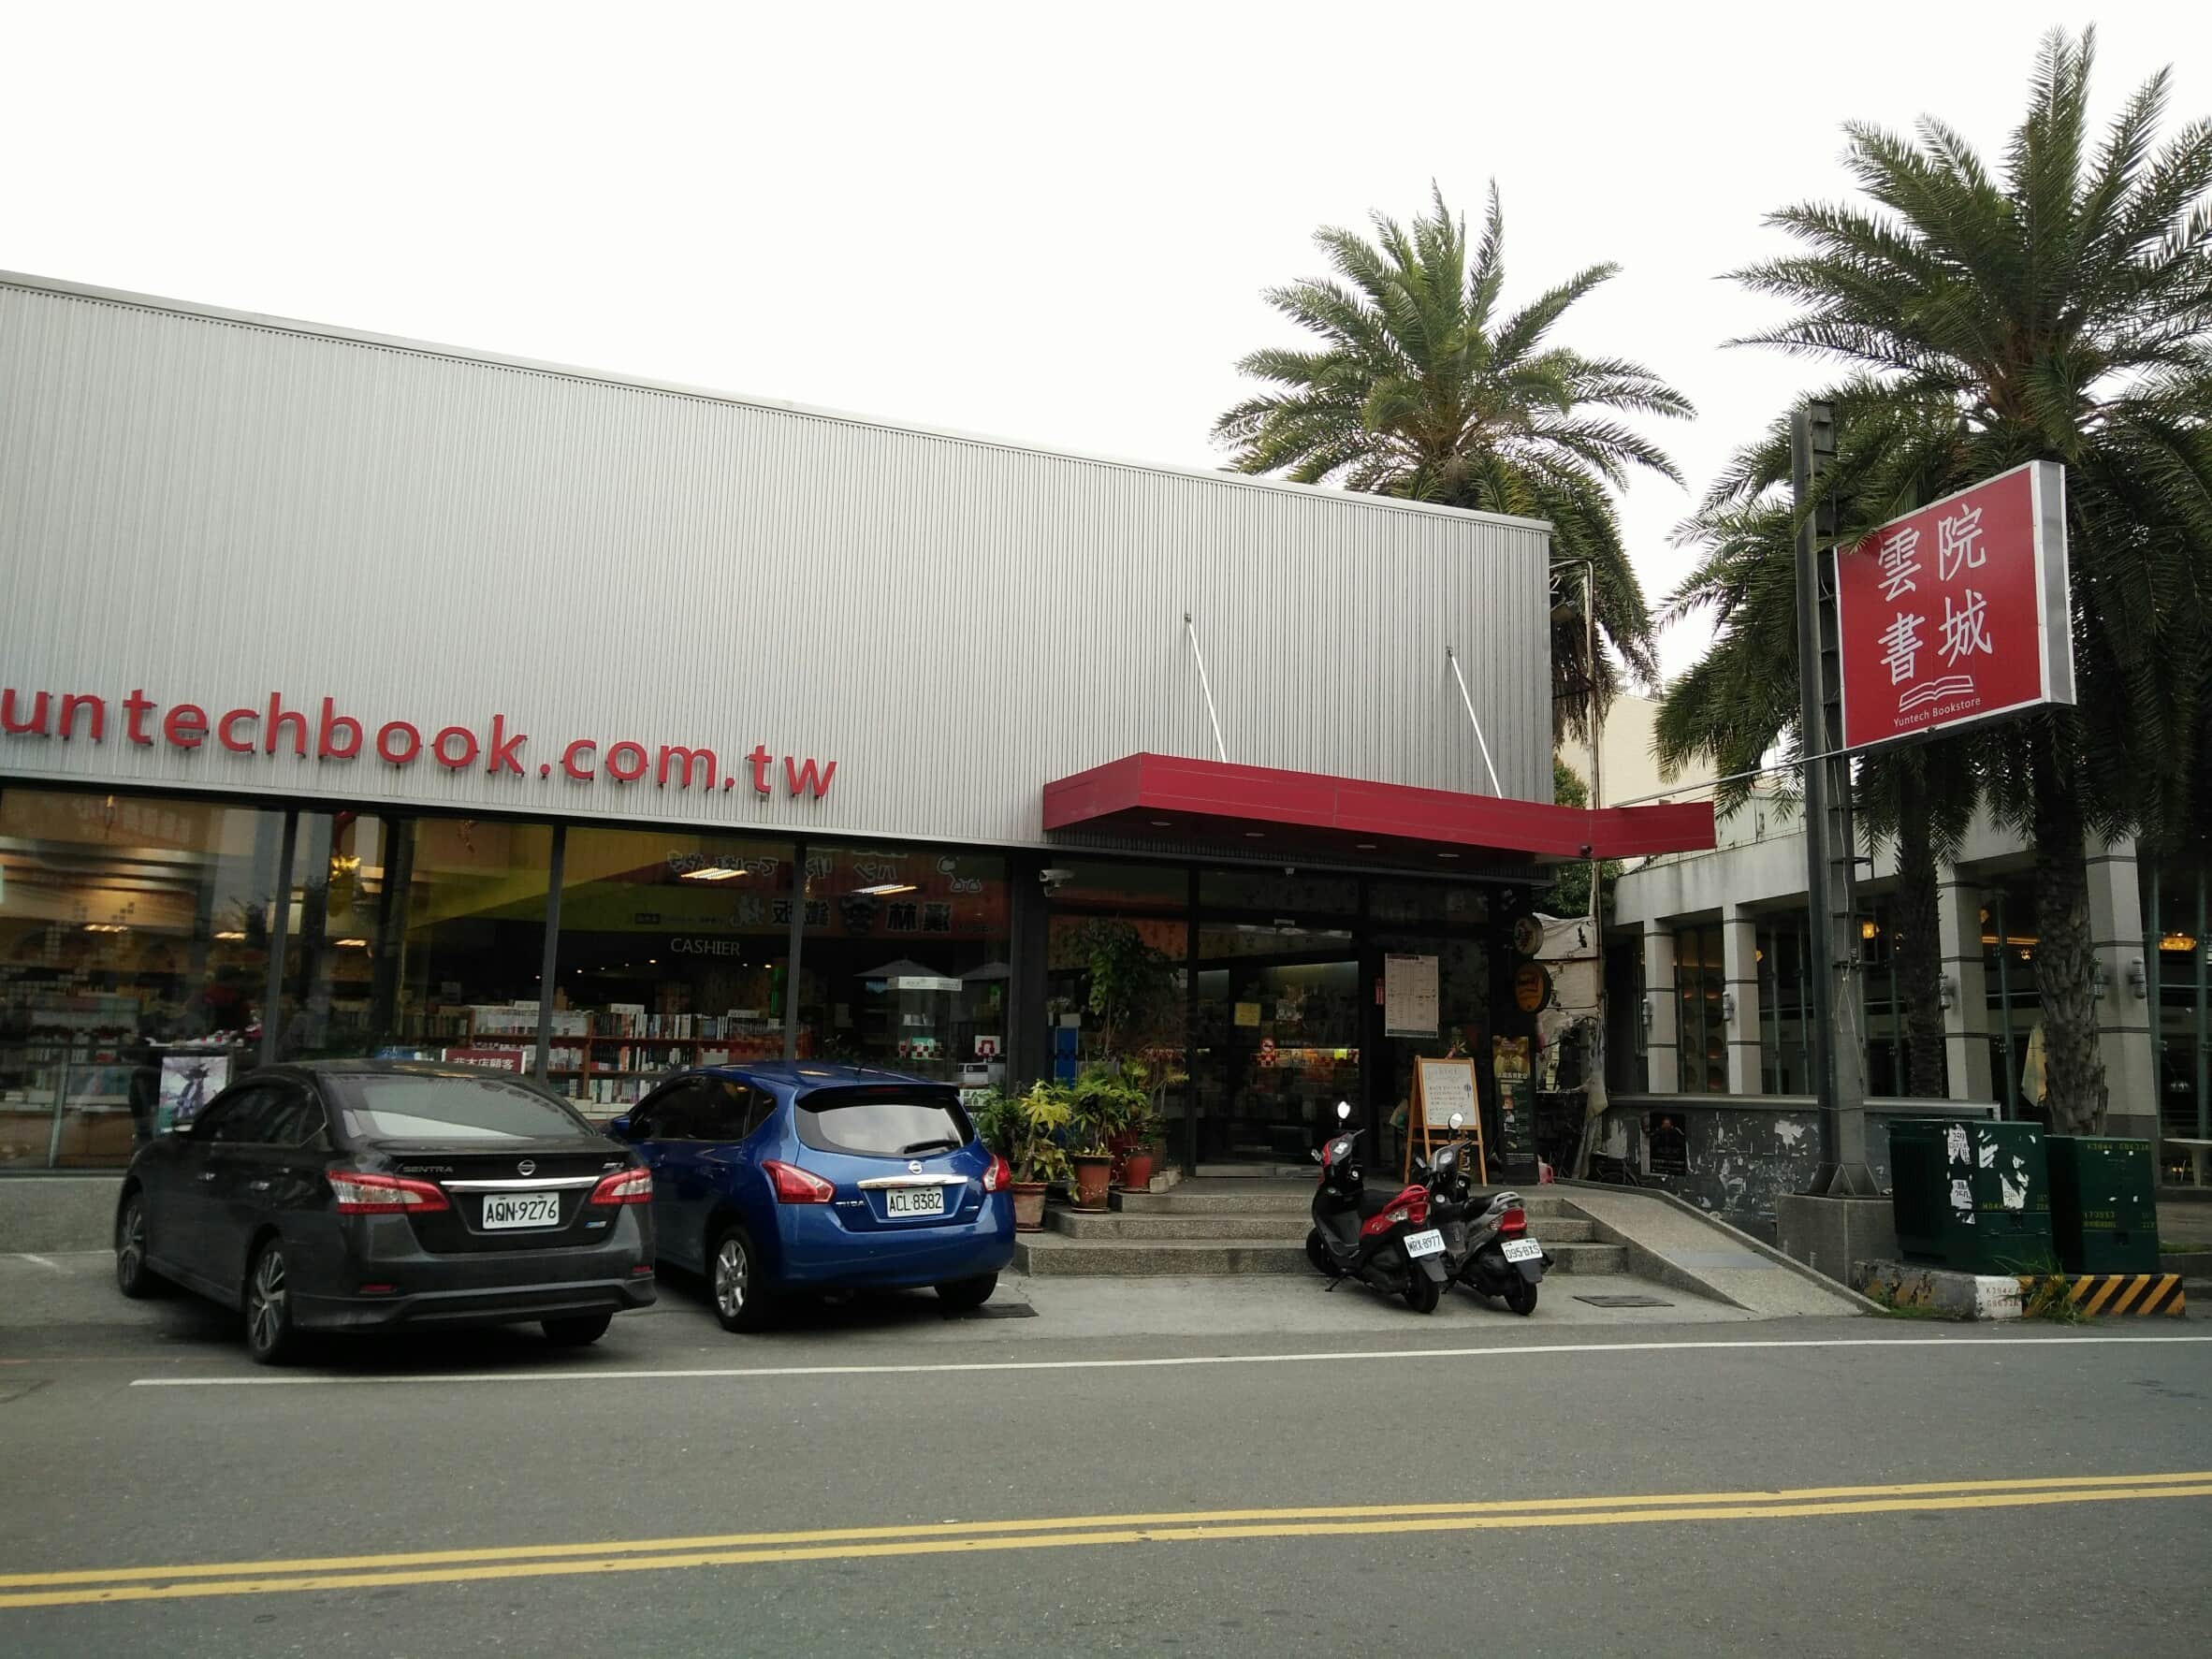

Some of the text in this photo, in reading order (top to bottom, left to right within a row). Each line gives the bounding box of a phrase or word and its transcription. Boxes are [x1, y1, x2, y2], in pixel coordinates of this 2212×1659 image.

[1877, 589, 1993, 687] 書城
[1, 689, 837, 798] untechbook.com.tw
[1893, 696, 1981, 727] Yuntech Bookstore
[670, 937, 741, 957] CASHIER
